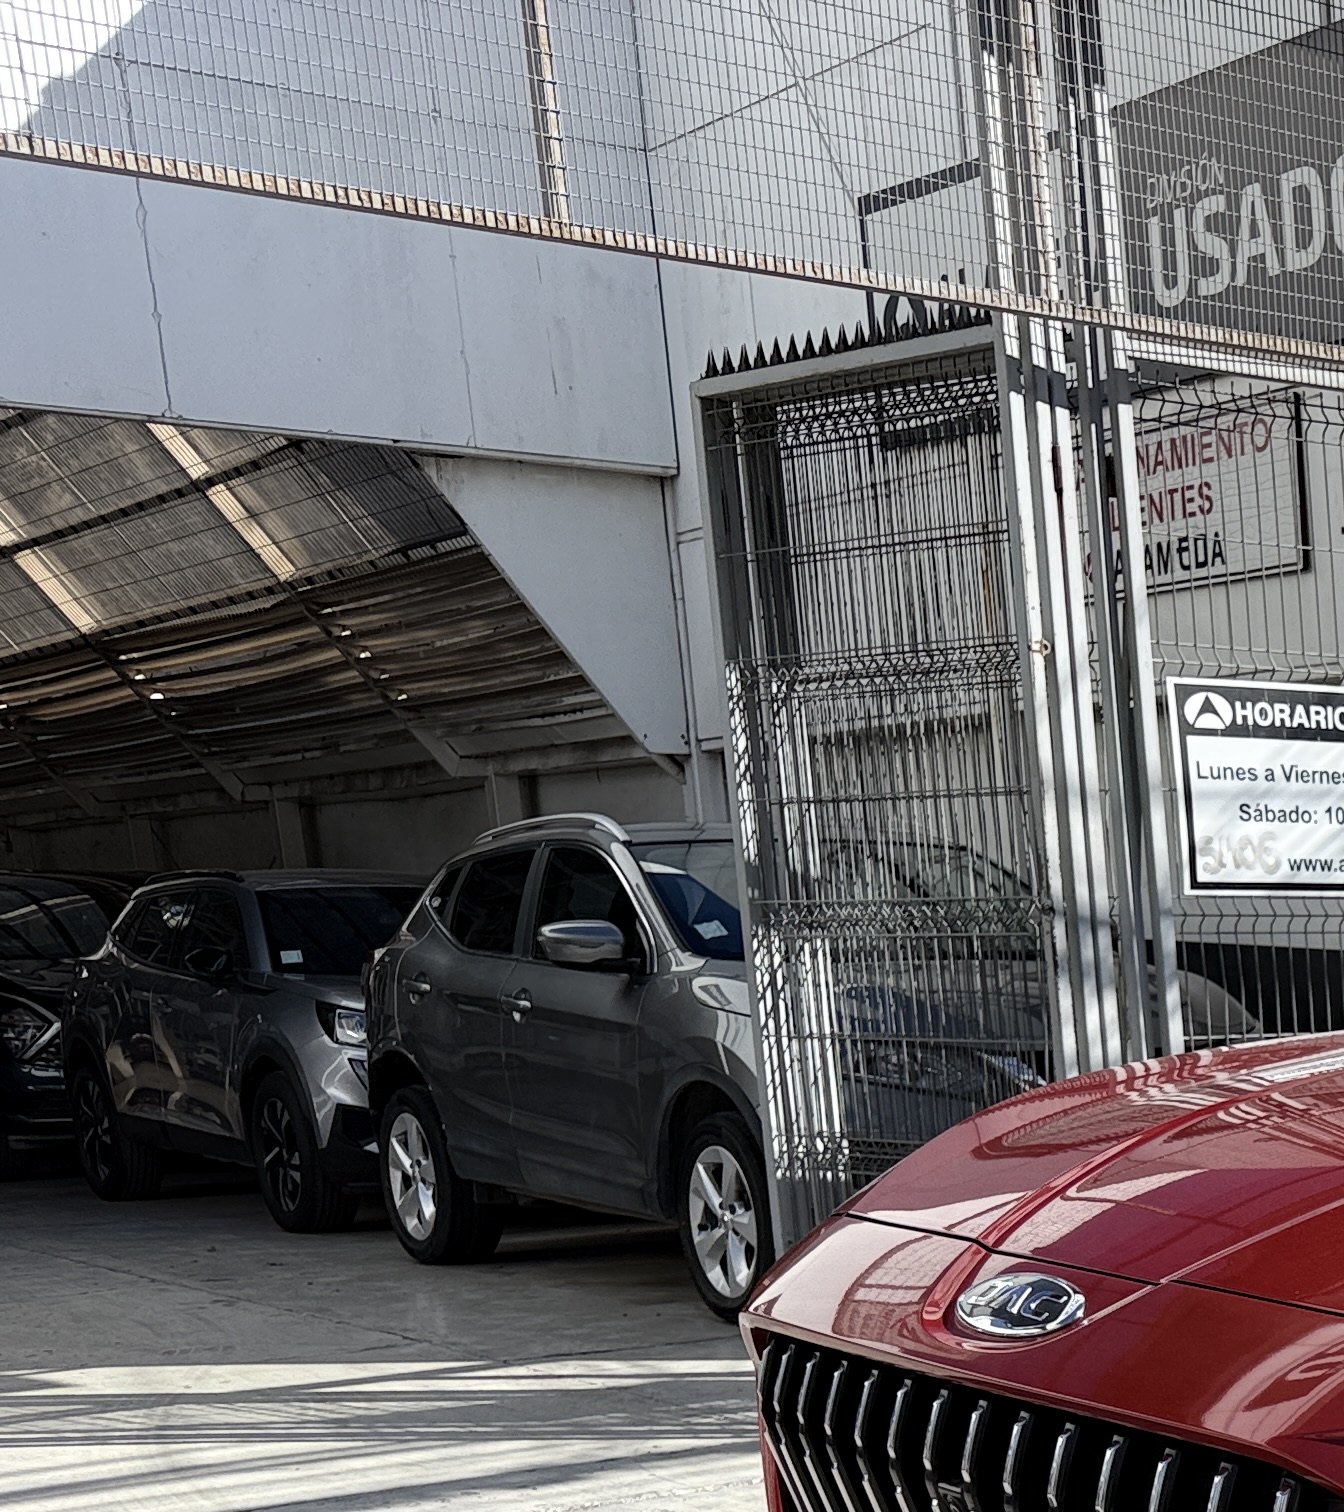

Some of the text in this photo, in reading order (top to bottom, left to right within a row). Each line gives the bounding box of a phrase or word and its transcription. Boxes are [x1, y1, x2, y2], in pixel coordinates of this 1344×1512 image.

[1196, 760, 1258, 781] Lunes
[1264, 768, 1276, 783] a
[1239, 803, 1318, 824] Sábado:
[966, 1279, 1068, 1322] JAC
